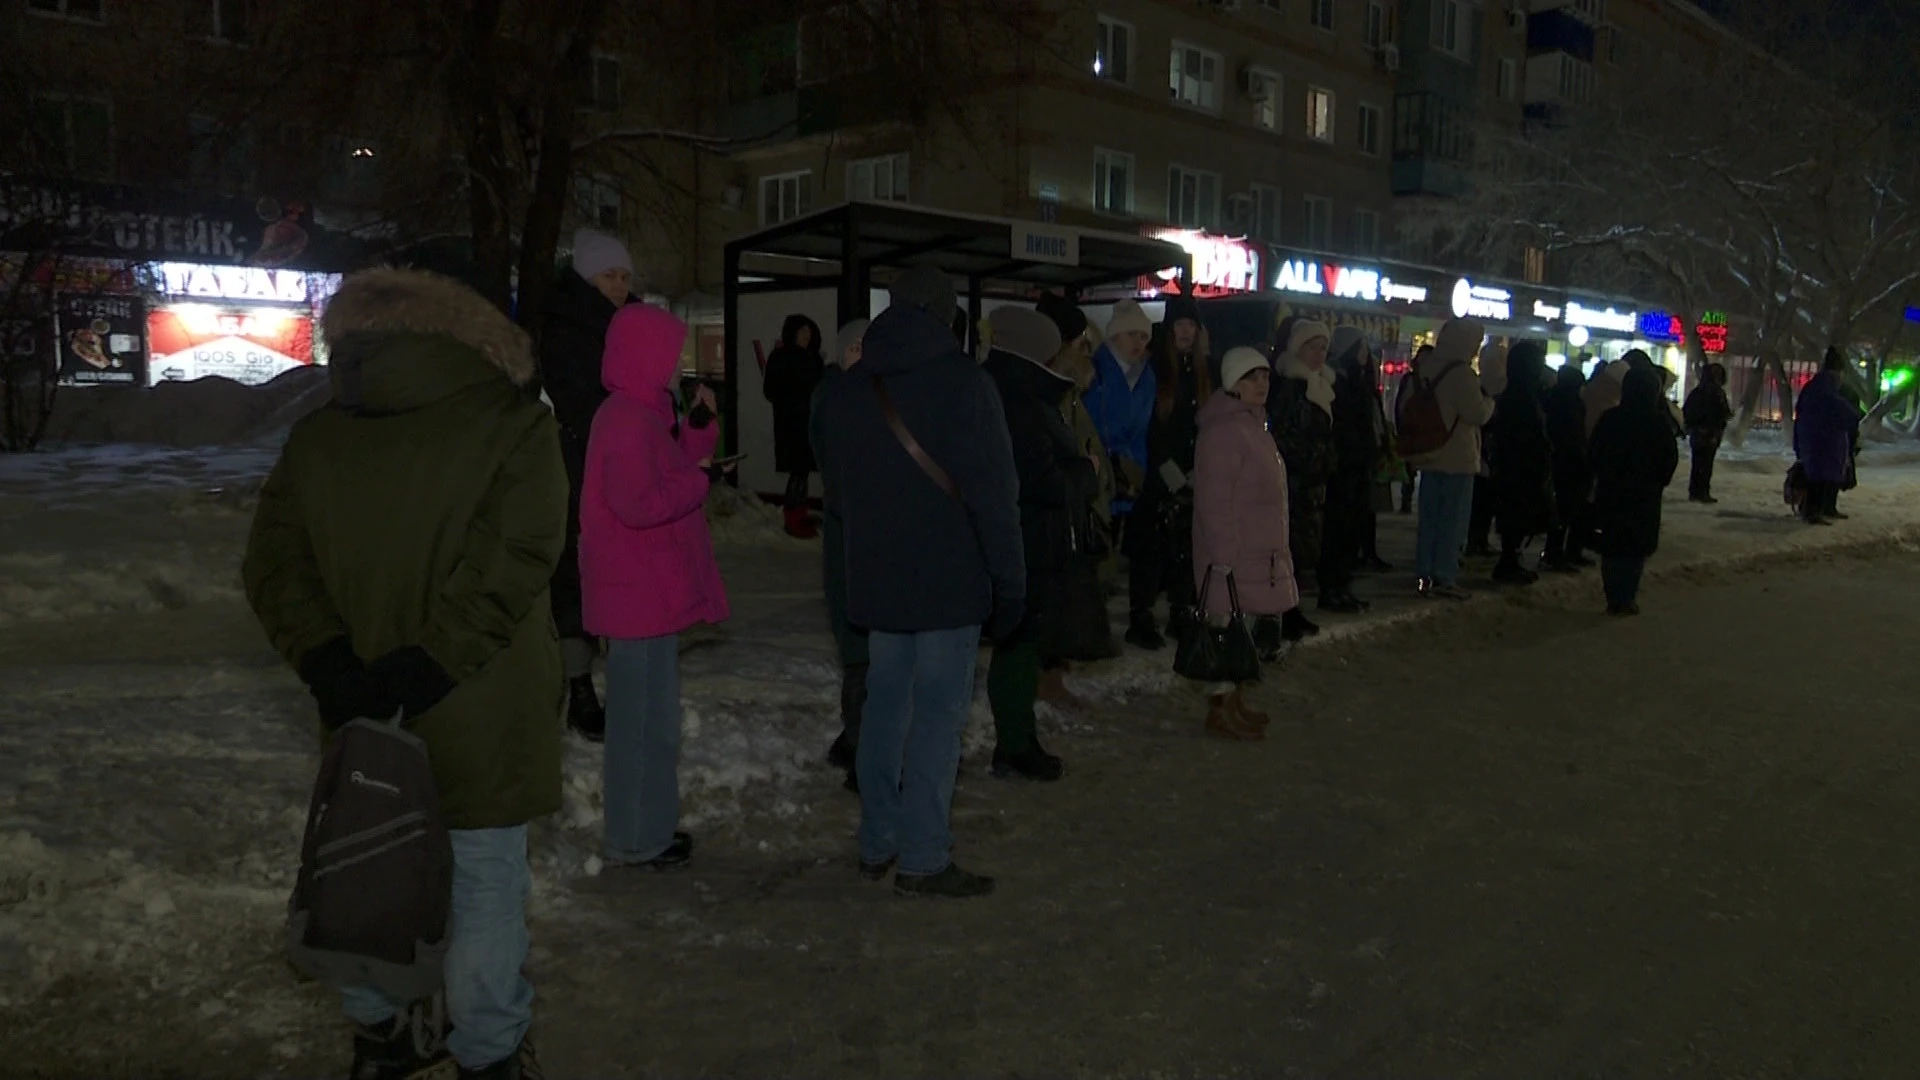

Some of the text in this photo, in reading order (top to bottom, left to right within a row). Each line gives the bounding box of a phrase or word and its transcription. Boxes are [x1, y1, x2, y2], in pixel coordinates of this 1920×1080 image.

[164, 263, 306, 301] ТАБАК
[1274, 260, 1323, 293] ALL
[1324, 266, 1378, 300] VAPE
[193, 351, 235, 363] IQOS
